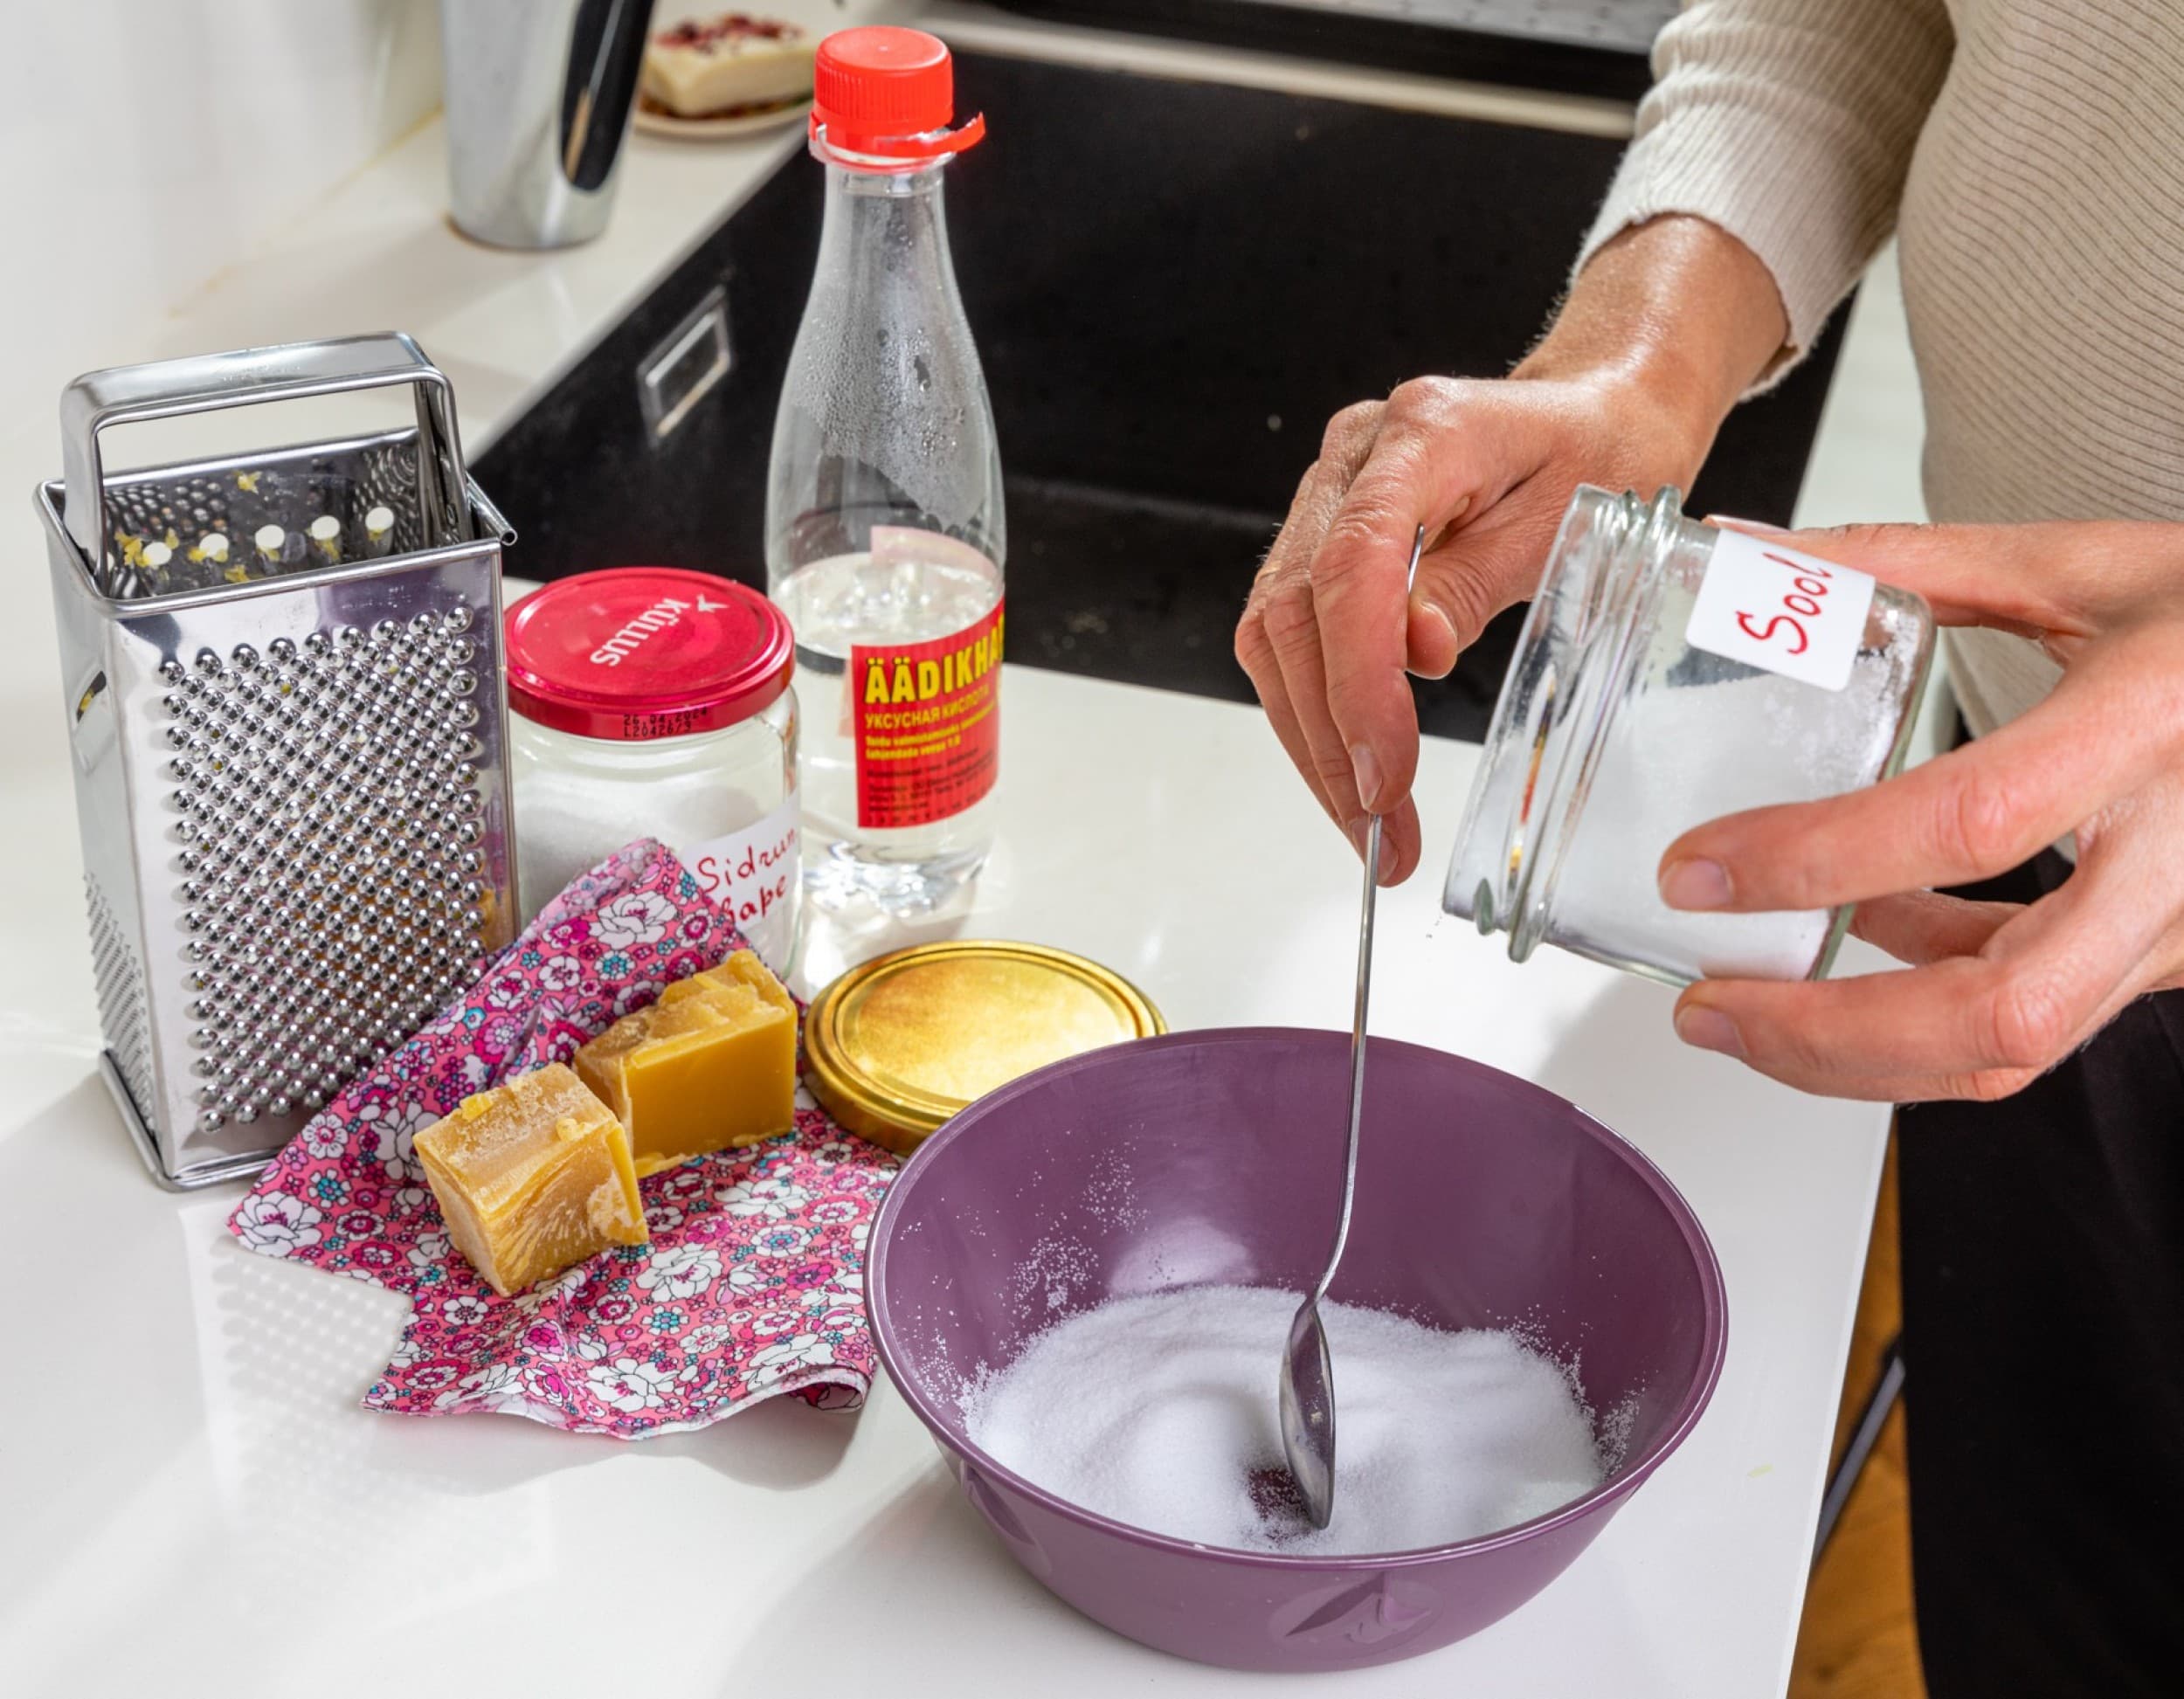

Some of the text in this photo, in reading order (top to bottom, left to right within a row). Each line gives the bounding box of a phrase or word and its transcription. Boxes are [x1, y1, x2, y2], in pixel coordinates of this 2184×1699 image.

[590, 597, 691, 666] KÜLLUS
[1735, 552, 1833, 654] Sool
[865, 706, 941, 730] УКСУСНАЯ
